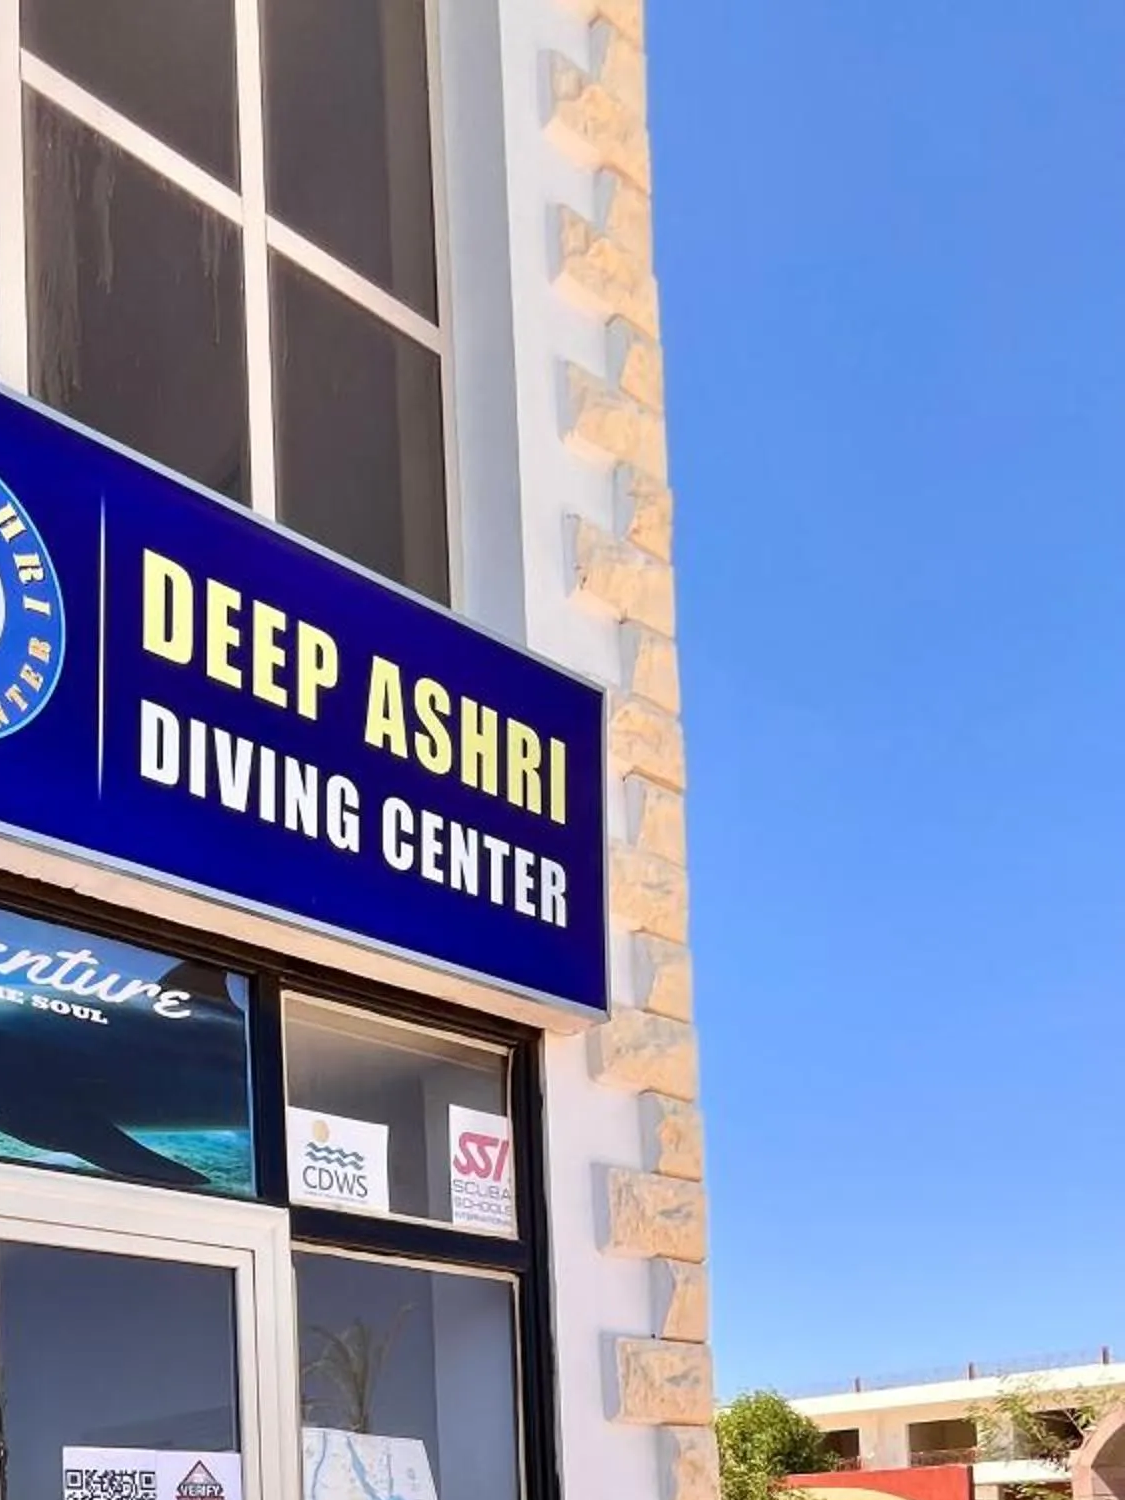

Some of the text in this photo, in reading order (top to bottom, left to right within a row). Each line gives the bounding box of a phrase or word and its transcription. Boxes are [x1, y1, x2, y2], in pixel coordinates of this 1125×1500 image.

[142, 547, 567, 824] DEEP ASHRI
[140, 699, 569, 927] DIVING CENTER
[31, 991, 109, 1026] SOUL
[452, 1131, 510, 1182] SSI
[302, 1165, 369, 1198] CDWS
[452, 1178, 512, 1200] SCUBA
[180, 1484, 221, 1497] VERIFY
